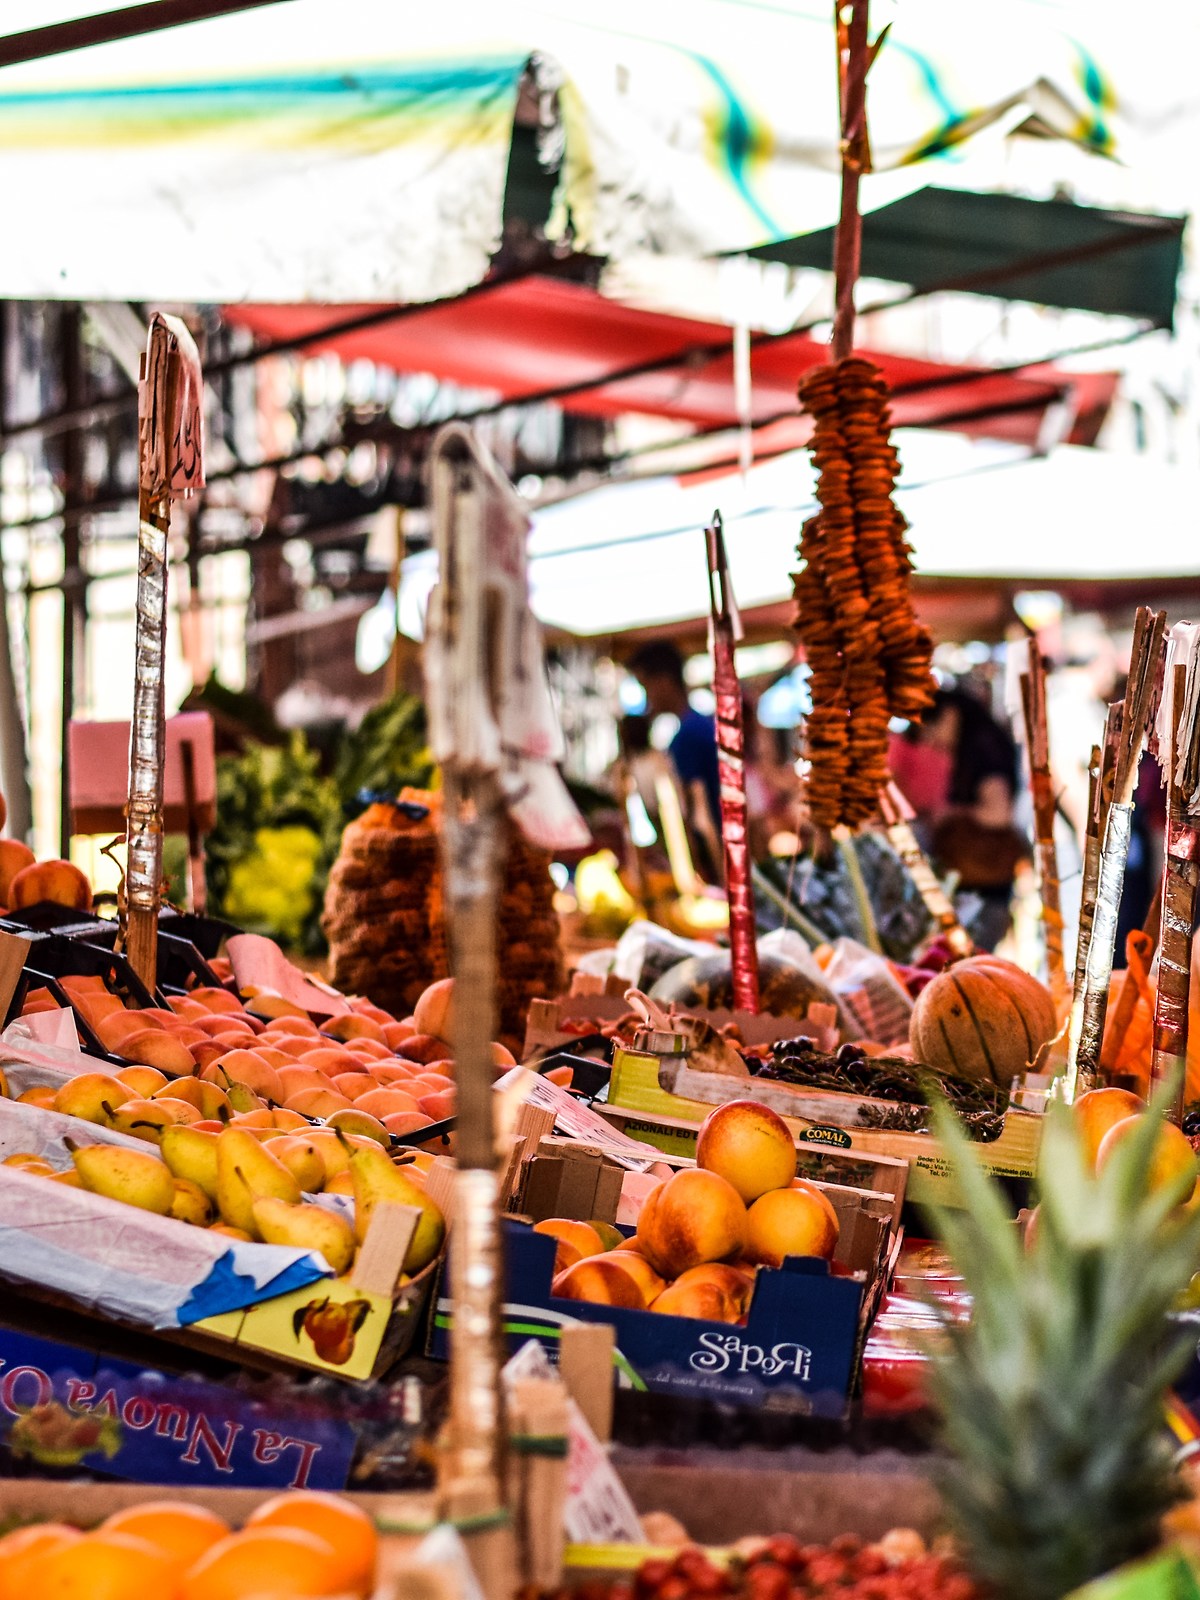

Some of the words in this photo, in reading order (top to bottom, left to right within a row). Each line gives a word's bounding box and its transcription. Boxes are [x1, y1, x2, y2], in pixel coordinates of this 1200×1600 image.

[676, 1130, 690, 1139] ED
[806, 1129, 846, 1143] COMAL
[991, 1166, 1018, 1175] Villabate
[1019, 1169, 1033, 1177] (PA)
[0, 1358, 53, 1417] O
[66, 1377, 244, 1474] Nuova
[253, 1428, 322, 1490] La
